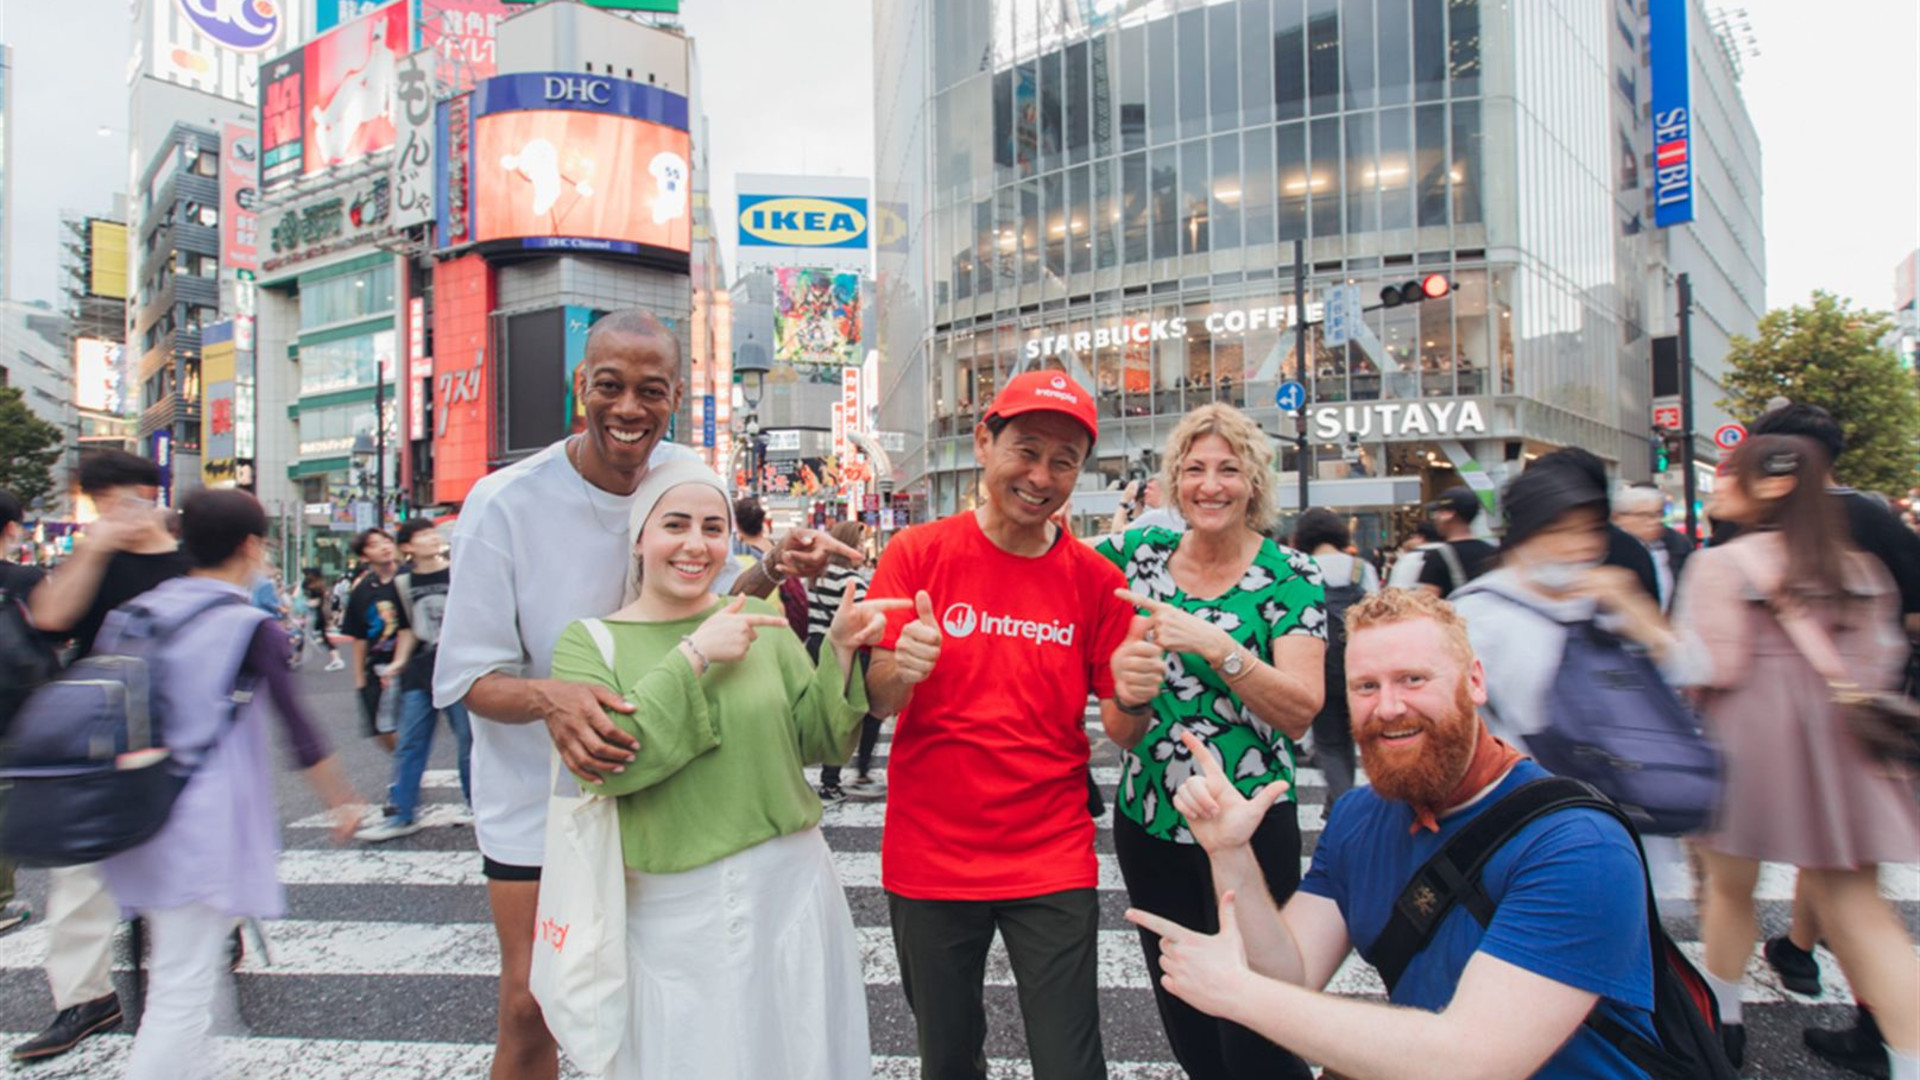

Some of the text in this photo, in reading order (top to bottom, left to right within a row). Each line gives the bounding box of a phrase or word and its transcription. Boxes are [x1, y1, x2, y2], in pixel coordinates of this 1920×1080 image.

[544, 76, 610, 104] DHC
[397, 56, 430, 216] もんじゃ
[1655, 107, 1688, 205] SEIBU
[752, 211, 857, 232] IKEA
[548, 239, 569, 248] DHC
[1026, 317, 1187, 359] STARBUCKS
[437, 347, 484, 437] クスリ
[981, 611, 1075, 646] Intrepid
